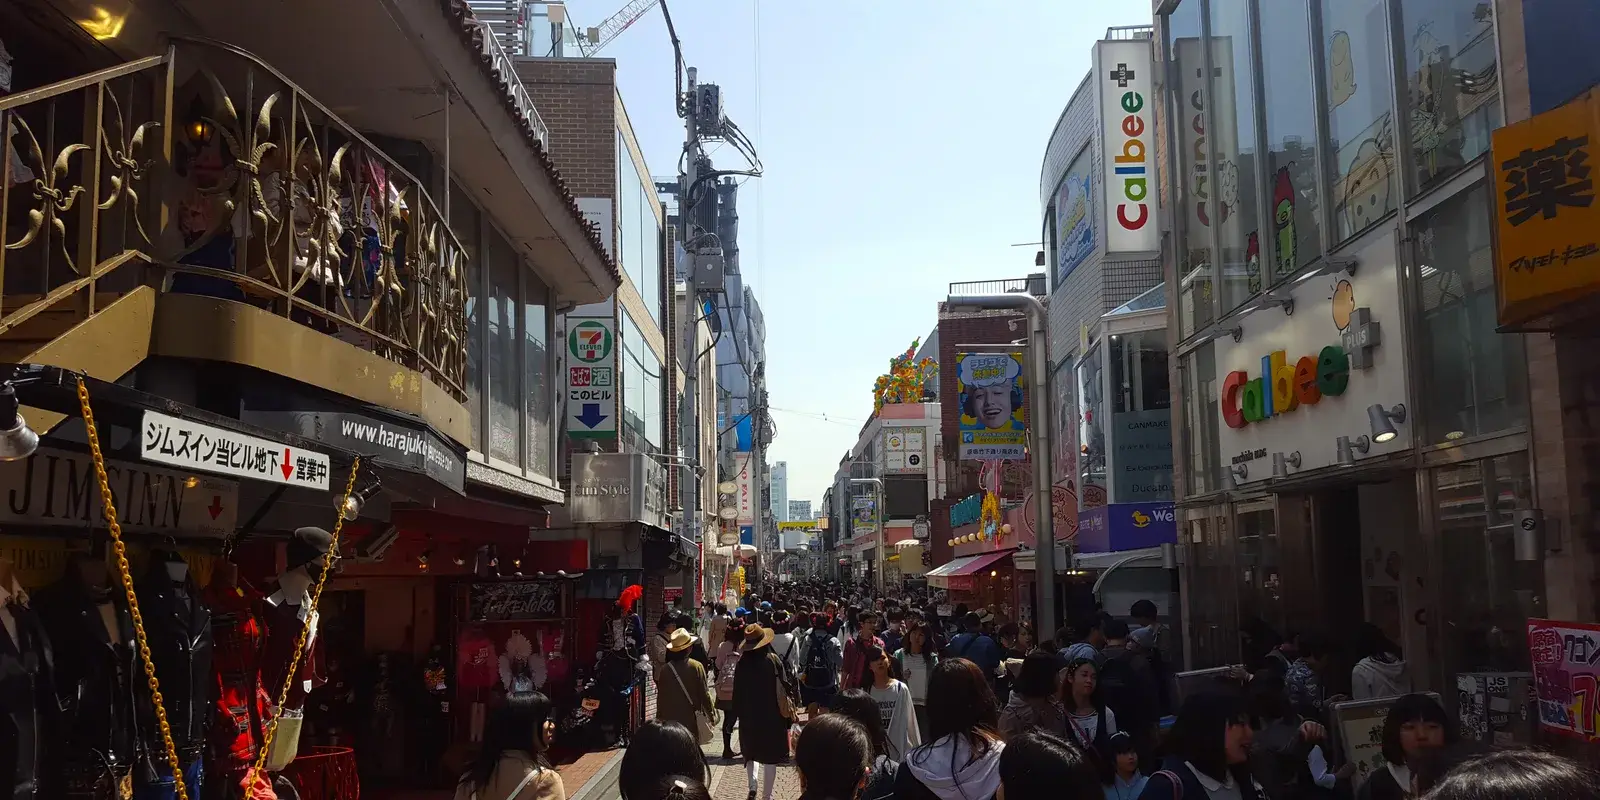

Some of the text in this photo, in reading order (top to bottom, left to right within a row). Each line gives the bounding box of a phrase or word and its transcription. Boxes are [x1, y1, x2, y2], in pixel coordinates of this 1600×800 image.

[1115, 91, 1148, 230] Calbee
[1501, 134, 1596, 227] 薬
[579, 331, 602, 359] 7
[1346, 330, 1367, 349] PLUS
[571, 368, 611, 385] たばこ 酒
[1221, 345, 1350, 428] Calbee
[571, 391, 611, 400] このビル
[1128, 420, 1169, 430] CANMAKE
[146, 422, 327, 484] ジムズイン当ビル地下 営業中
[600, 484, 631, 498] Style
[1489, 677, 1506, 686] JS
[1572, 673, 1600, 734] 7
